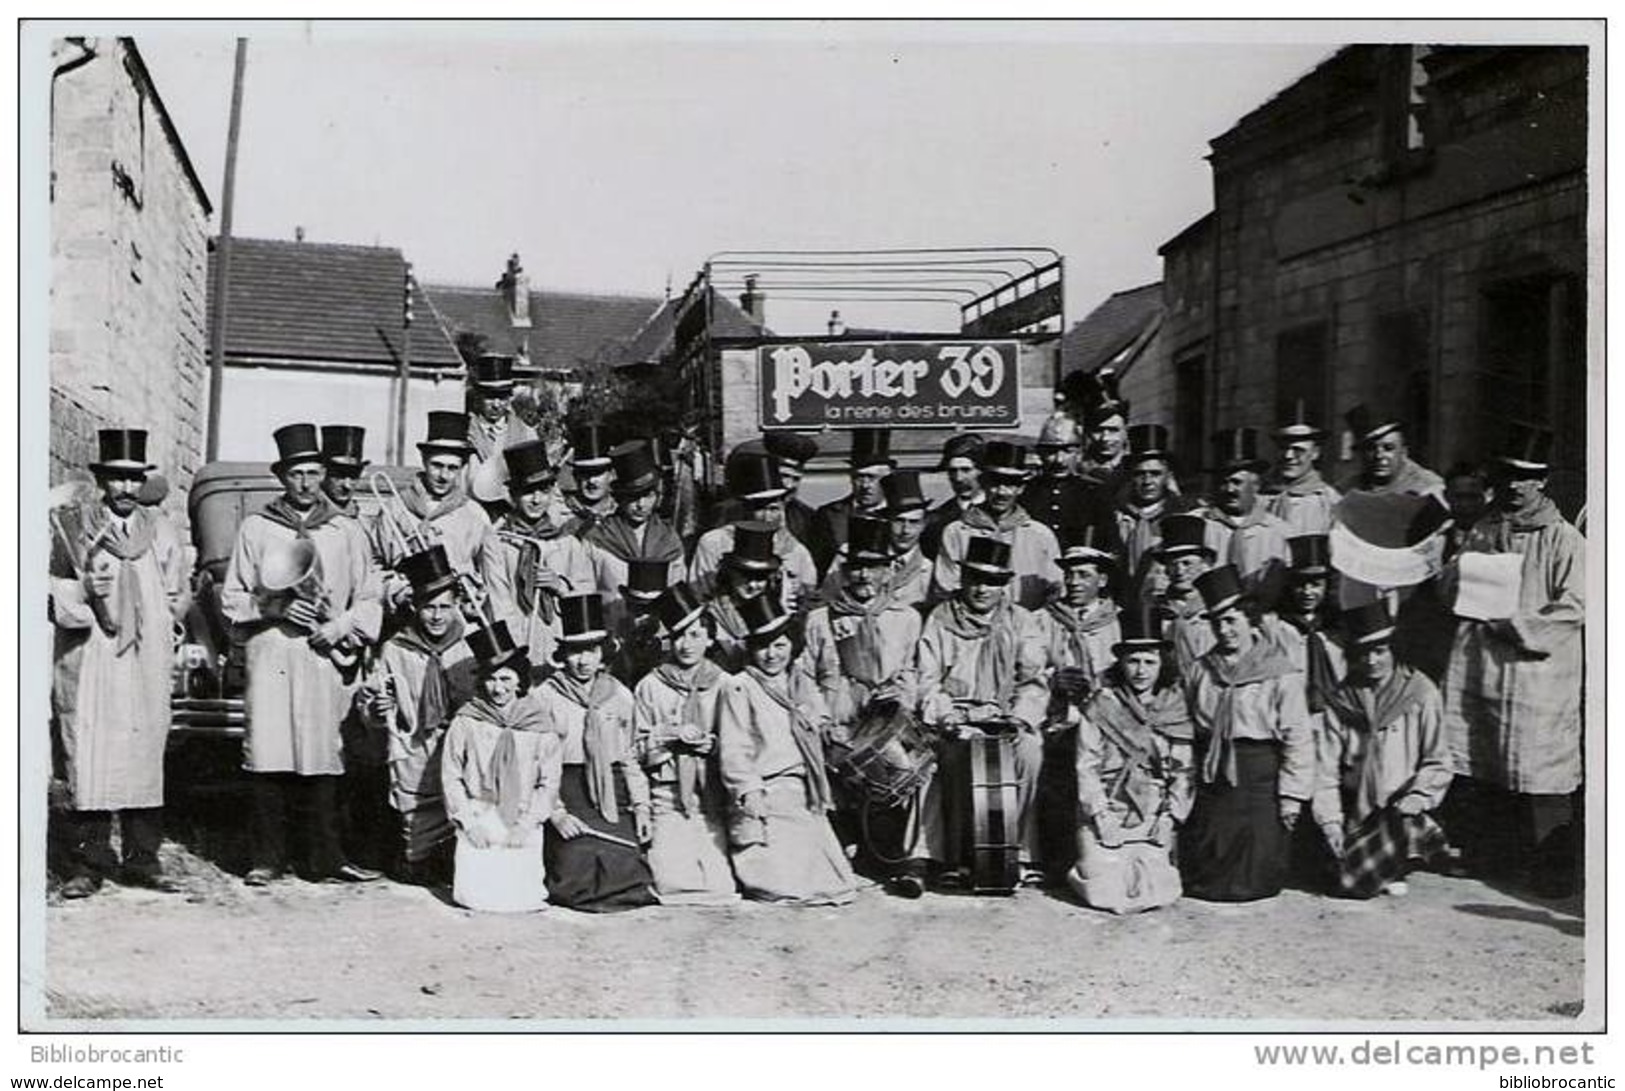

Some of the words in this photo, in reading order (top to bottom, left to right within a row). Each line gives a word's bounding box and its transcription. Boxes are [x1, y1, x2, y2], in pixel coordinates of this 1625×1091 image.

[770, 346, 929, 423] Porter
[938, 346, 1005, 398] 39
[825, 403, 841, 419] la
[898, 402, 935, 418] des
[938, 402, 1009, 418] brunes
